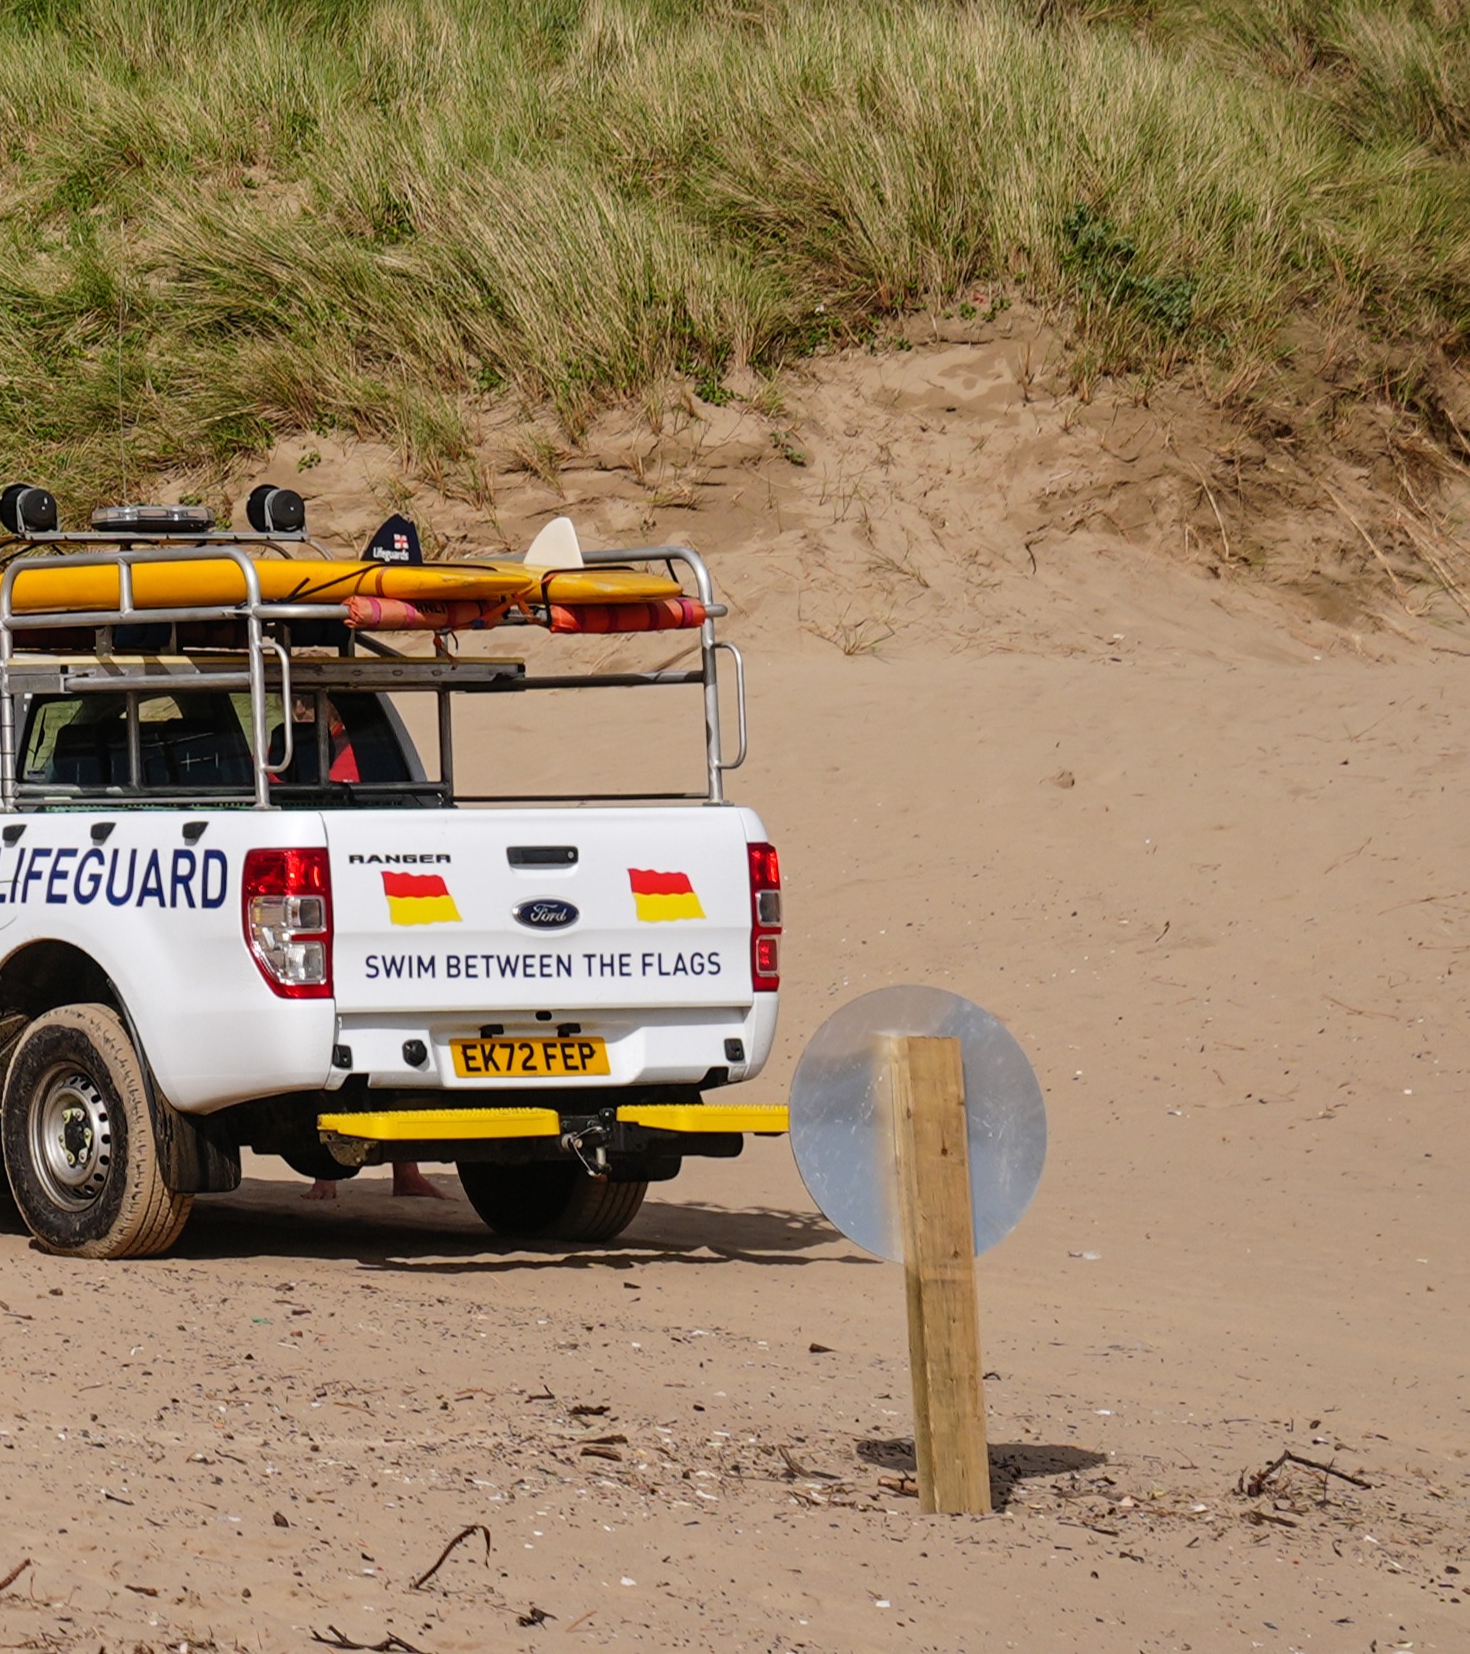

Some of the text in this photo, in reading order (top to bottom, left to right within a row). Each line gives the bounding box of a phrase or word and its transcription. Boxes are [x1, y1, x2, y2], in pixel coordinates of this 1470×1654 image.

[372, 547, 409, 562] Lifeguards
[348, 853, 452, 865] RANGER
[530, 903, 567, 923] Ford
[365, 952, 721, 979] SWIM BETWEEN THE FLAGS
[461, 1042, 595, 1073] EK72 FEP
